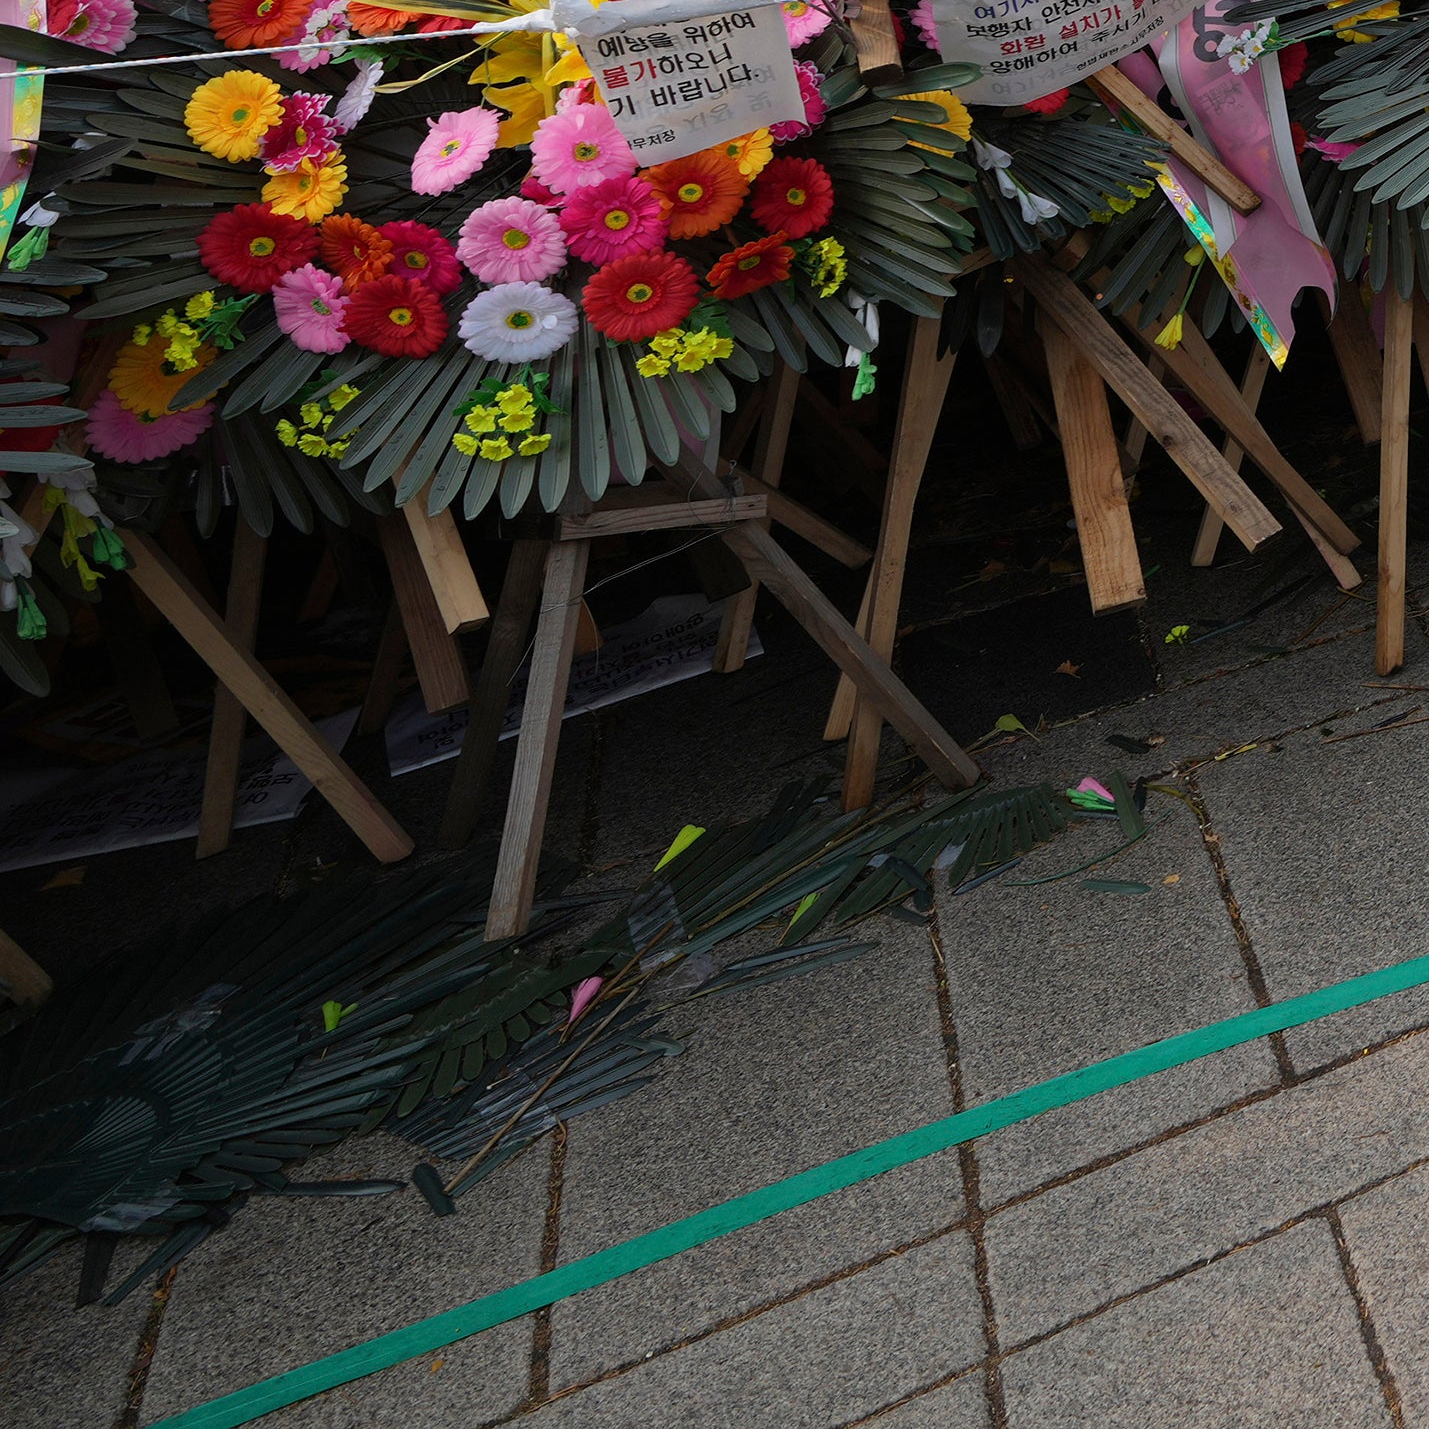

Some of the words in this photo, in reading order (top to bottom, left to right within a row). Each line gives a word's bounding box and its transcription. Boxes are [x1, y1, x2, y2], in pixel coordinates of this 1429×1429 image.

[597, 29, 675, 59] 예방을
[682, 11, 757, 46] 위하여
[966, 16, 1033, 40] 보행자
[989, 40, 1079, 76] 양해하여
[1091, 9, 1148, 43] 주시기
[1000, 34, 1047, 57] 화환
[1058, 4, 1122, 41] 설치가
[602, 42, 733, 91] 불가하오니
[649, 62, 760, 109] 바랍니다.
